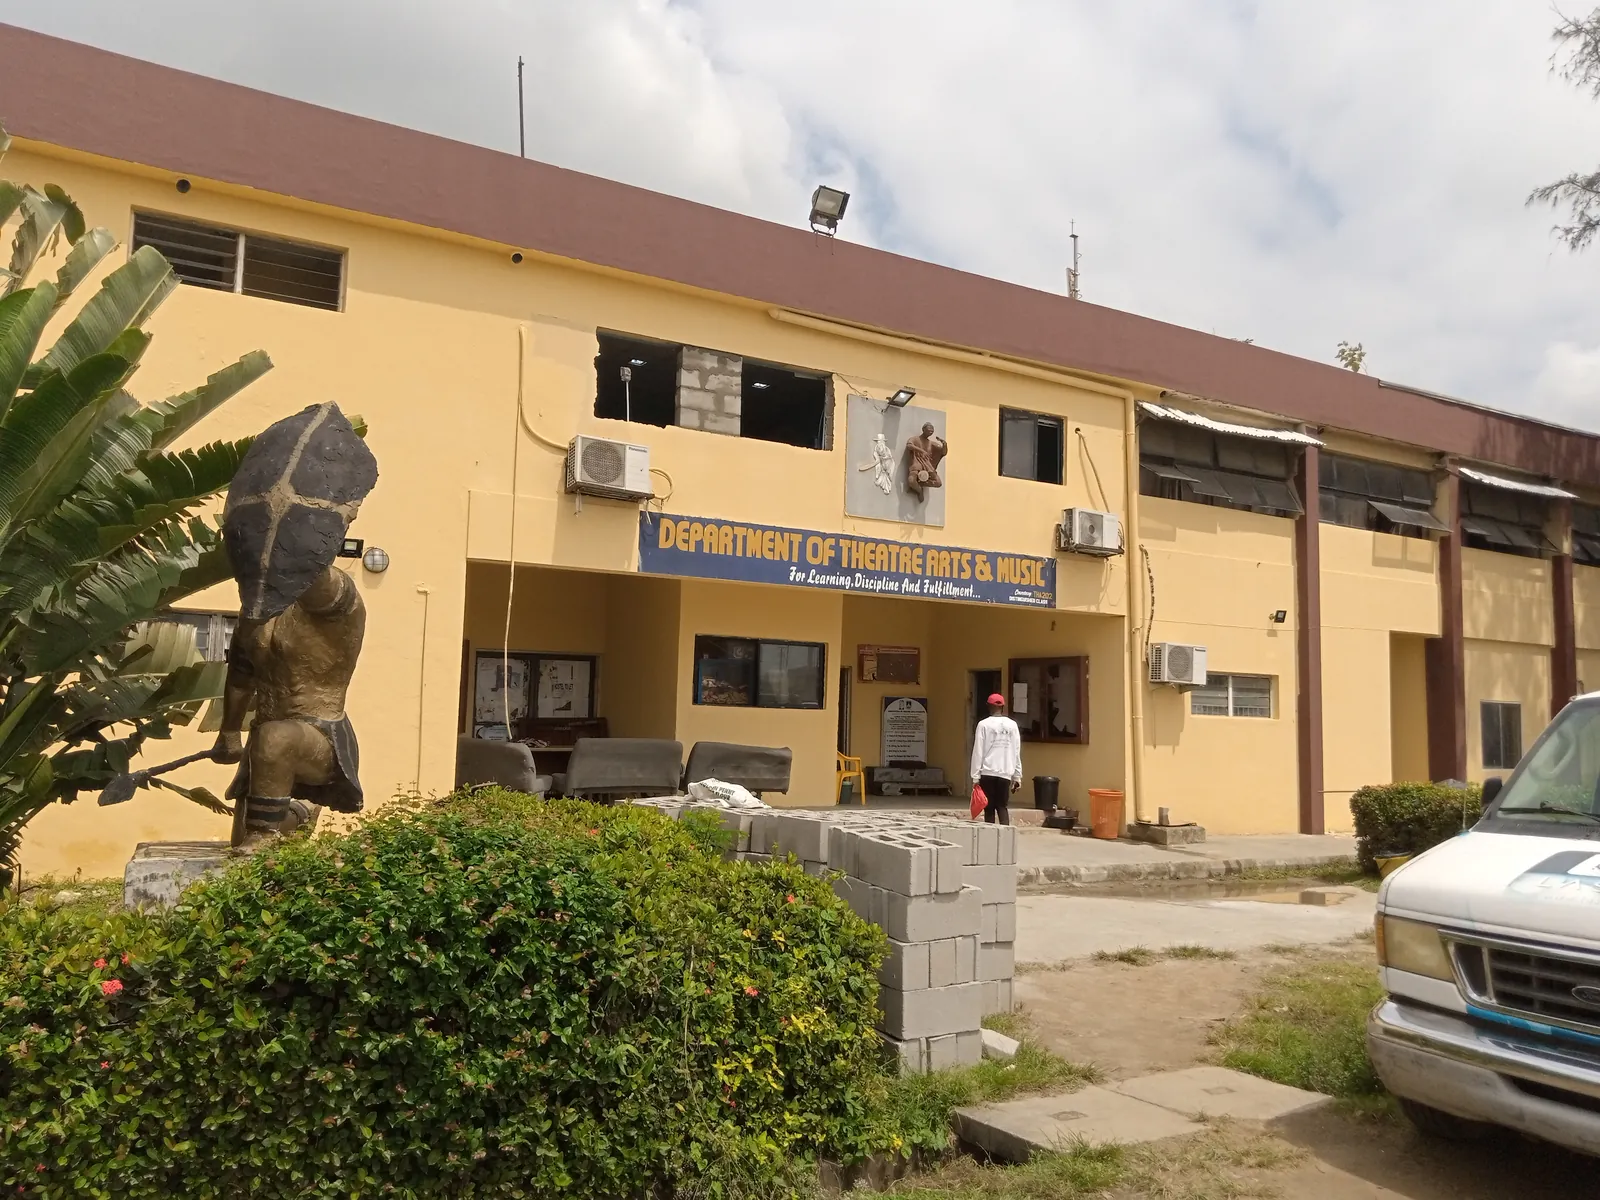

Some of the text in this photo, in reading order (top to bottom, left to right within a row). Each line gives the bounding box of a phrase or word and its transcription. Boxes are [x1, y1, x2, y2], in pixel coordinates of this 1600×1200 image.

[658, 518, 1046, 587] DEPARTMENT OF THEATRE ARTS & MUSIC
[788, 566, 806, 582] For
[901, 578, 921, 593] And
